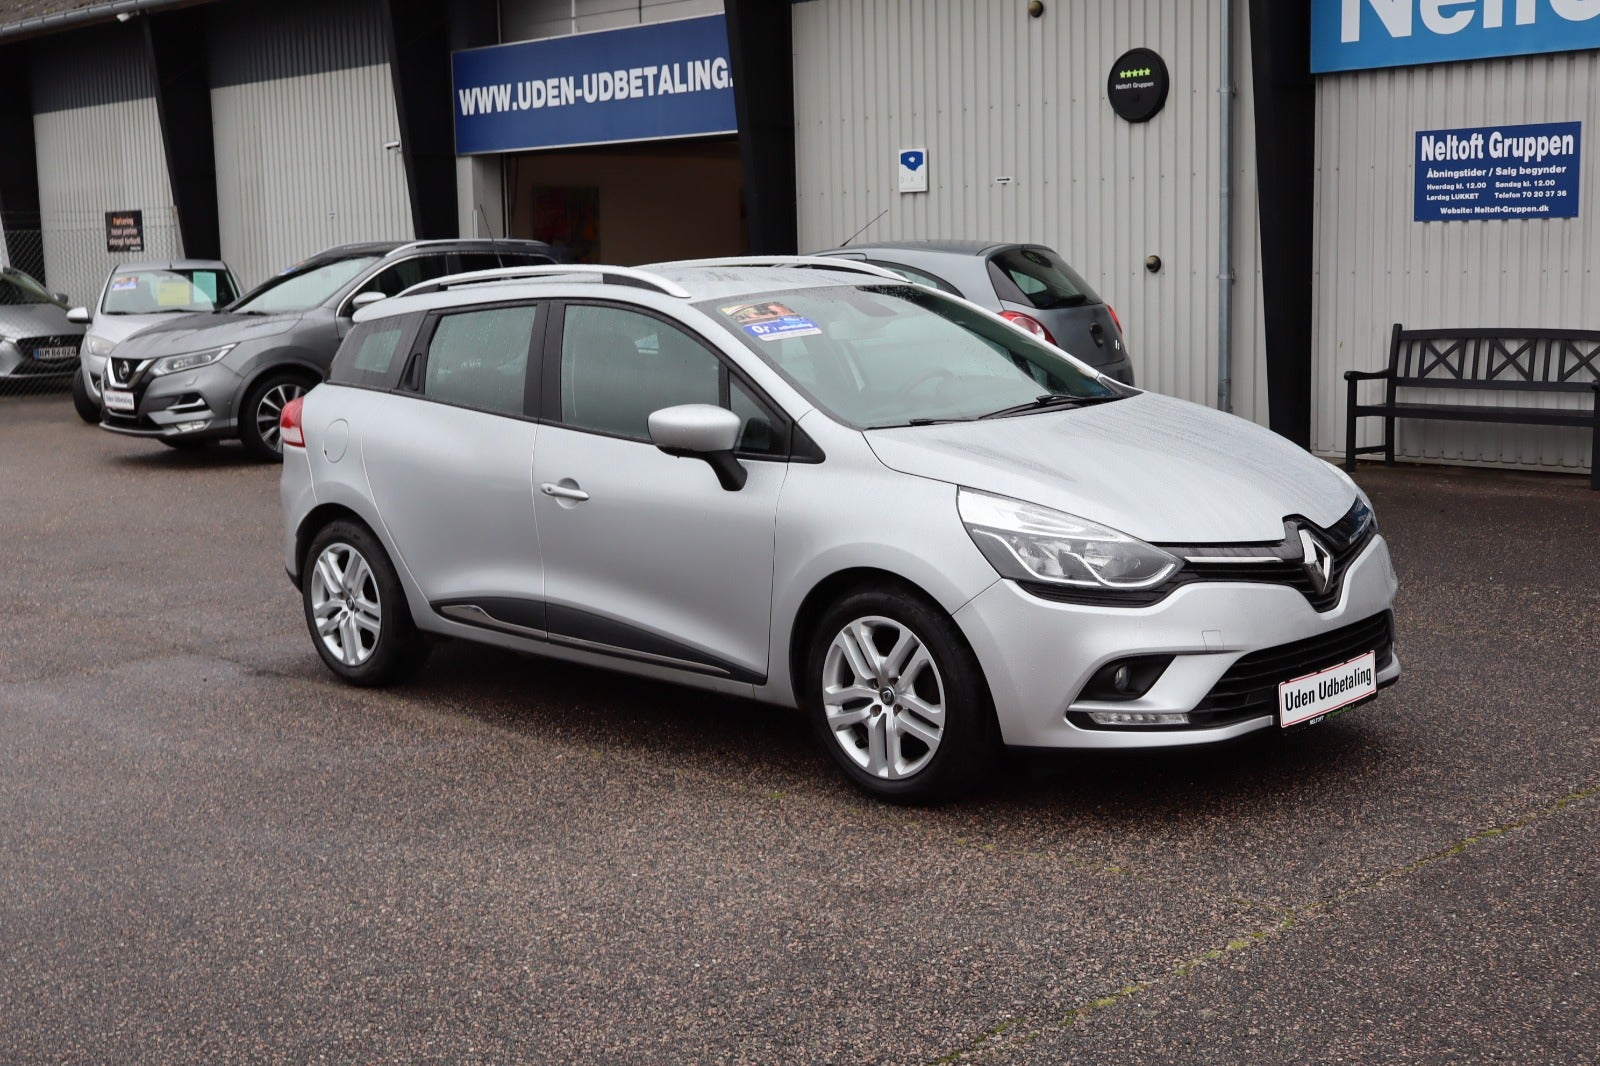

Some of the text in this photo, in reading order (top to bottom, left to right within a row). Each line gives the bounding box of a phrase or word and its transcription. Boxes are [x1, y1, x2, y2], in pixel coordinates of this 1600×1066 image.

[459, 57, 733, 115] WWW.UDEN-UDBETALING.
[1421, 131, 1574, 162] Neltoft Gruppen
[1427, 168, 1487, 179] Åbningstider
[1495, 166, 1517, 177] Salg
[1519, 165, 1567, 176] begynder
[1475, 205, 1549, 214] Neltoft-Gruppen.dk
[1285, 689, 1315, 711] Uden
[1318, 667, 1372, 700] Udbetaling
